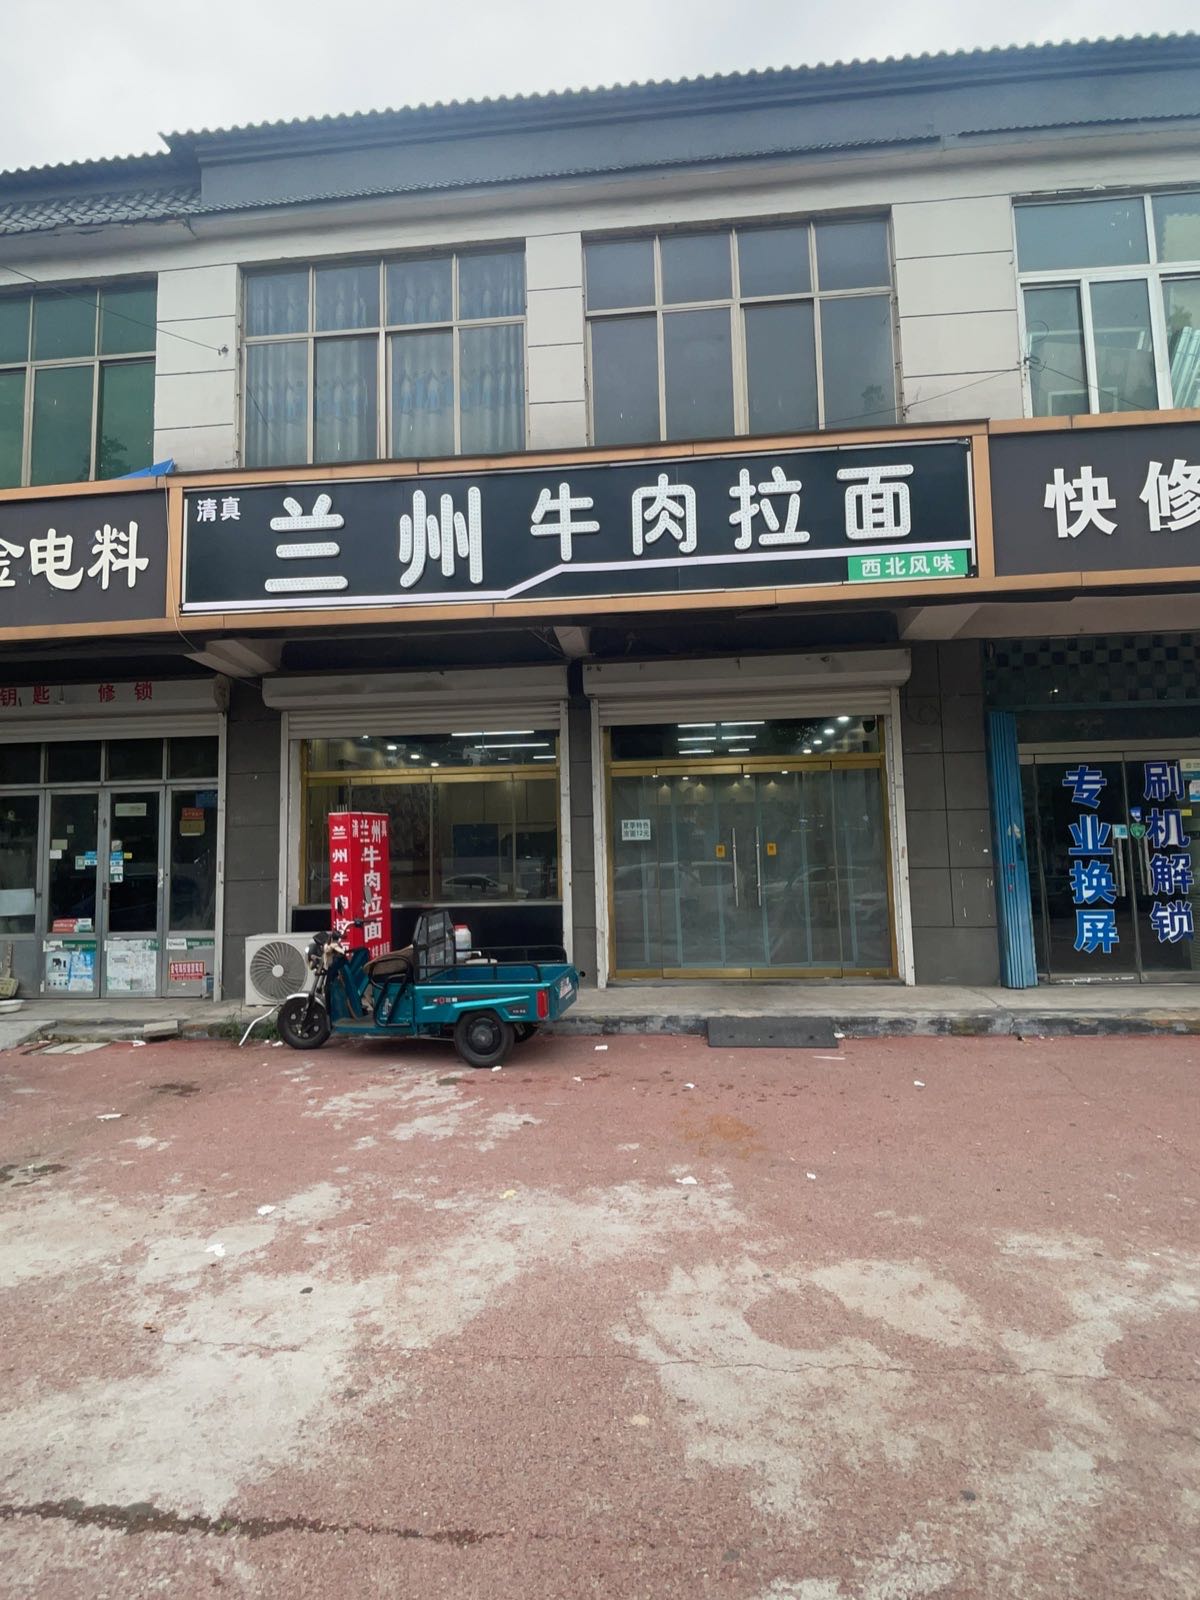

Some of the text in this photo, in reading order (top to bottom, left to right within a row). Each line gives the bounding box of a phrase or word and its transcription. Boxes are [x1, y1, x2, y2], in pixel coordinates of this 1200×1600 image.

[197, 496, 242, 522] 清真
[264, 464, 915, 593] 兰州牛肉拉面
[1043, 458, 1200, 539] 快修
[861, 553, 956, 578] 西北风味
[1062, 765, 1120, 954] 专业换屏
[1143, 760, 1195, 944] 刷机解锁
